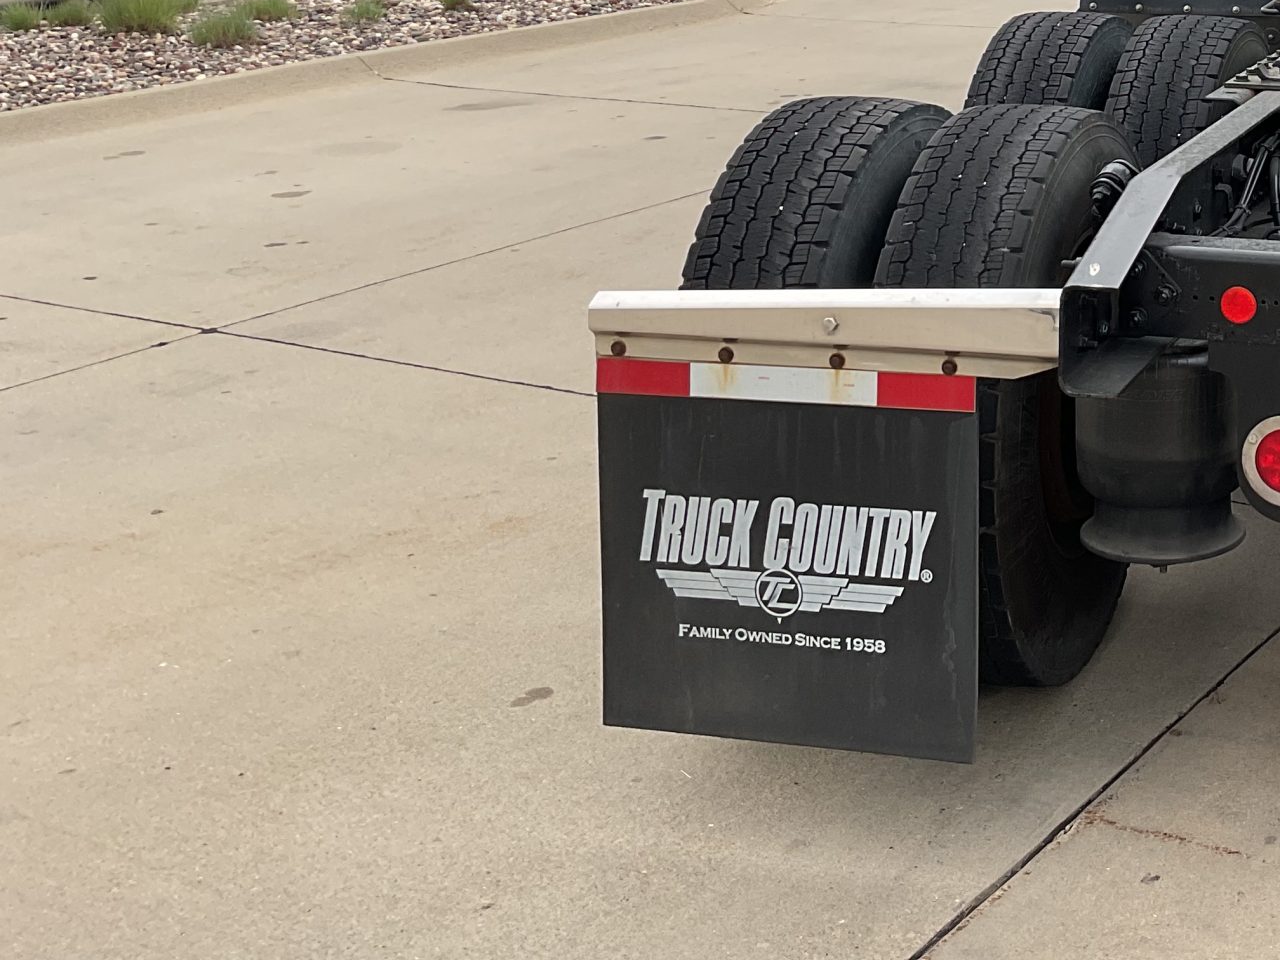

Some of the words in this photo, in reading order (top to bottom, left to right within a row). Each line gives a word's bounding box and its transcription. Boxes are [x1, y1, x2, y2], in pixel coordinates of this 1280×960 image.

[639, 488, 759, 568] TRUCK
[678, 623, 733, 640] FAMILY
[734, 628, 793, 646] OWNED
[794, 633, 841, 650] SINCE
[845, 637, 886, 654] 1958
